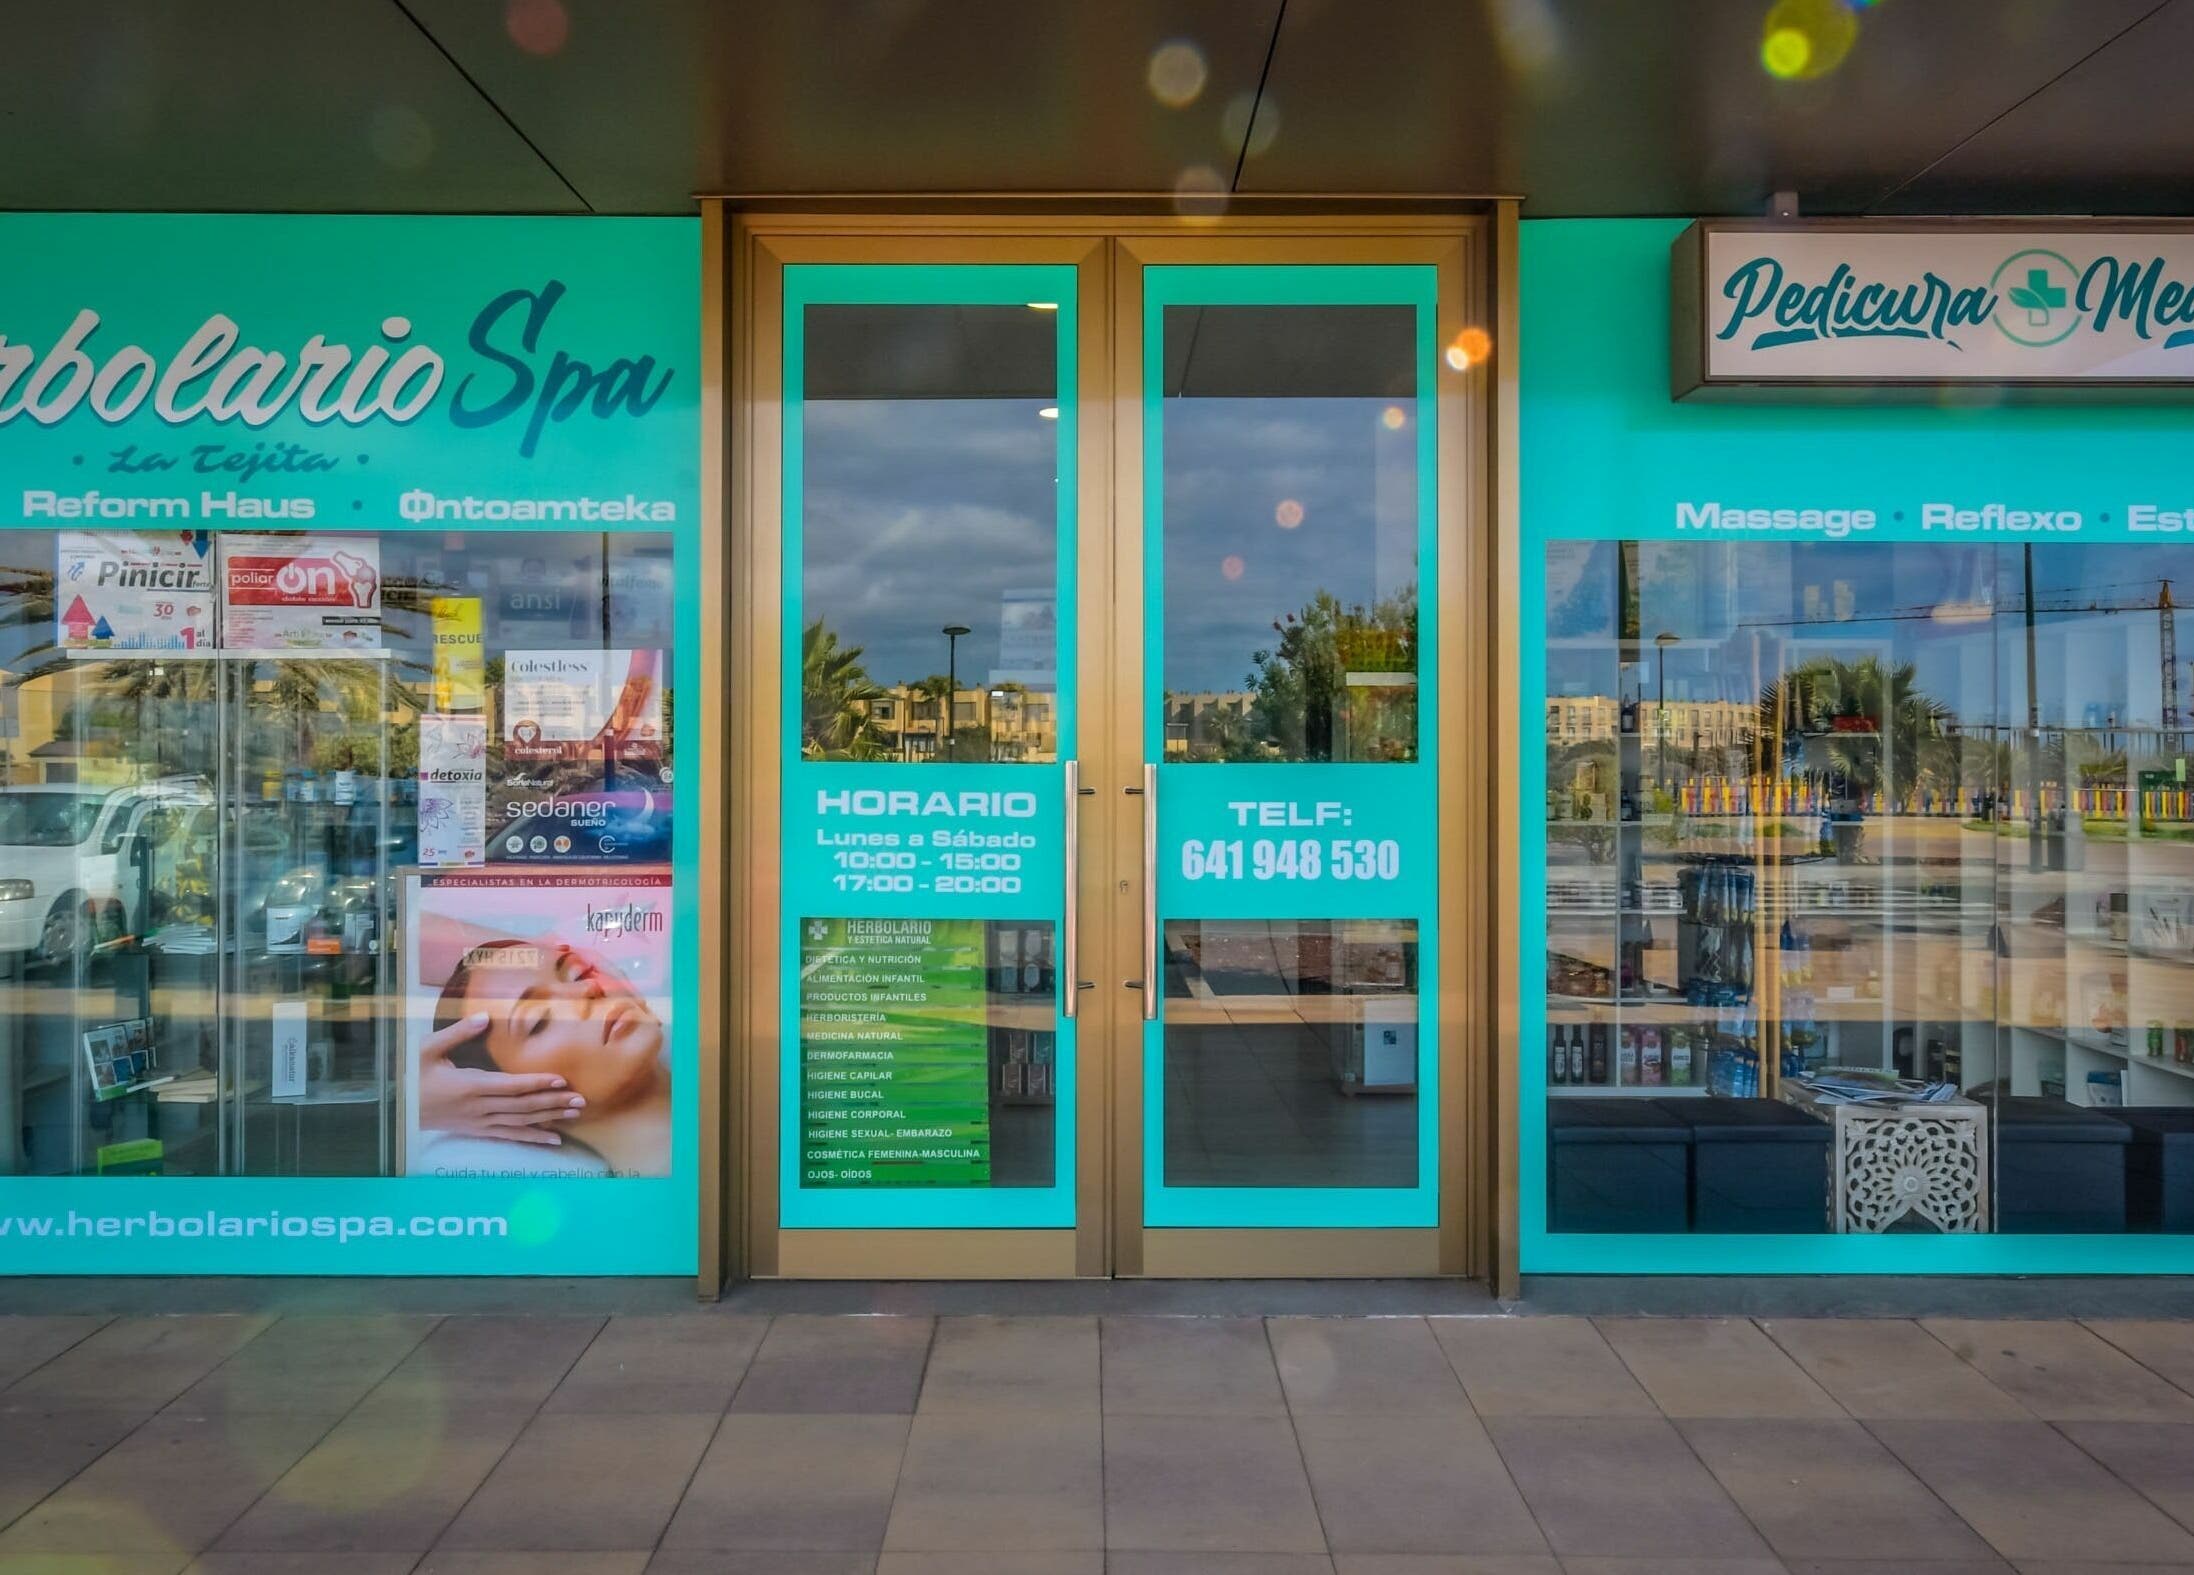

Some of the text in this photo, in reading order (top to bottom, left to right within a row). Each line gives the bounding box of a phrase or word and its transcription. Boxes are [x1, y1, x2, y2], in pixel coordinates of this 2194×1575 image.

[1715, 256, 1998, 341] Pedicura
[448, 279, 675, 459] Spa
[107, 441, 341, 484] La Tejita
[23, 490, 316, 520] Reform Haus
[1675, 502, 1877, 537] Massage
[1921, 503, 2083, 532] Reflexo
[97, 560, 200, 588] Pinicir
[231, 572, 274, 587] poliar
[153, 603, 174, 617] 30
[180, 627, 195, 650] 1
[506, 795, 617, 818] sedaner
[816, 789, 1037, 818] HORARIO
[570, 818, 607, 827] SUEÑO
[1227, 801, 1353, 826] TELF:
[816, 829, 1037, 848] Lunes a Sábado
[833, 851, 917, 869] 10:00
[939, 852, 1022, 871] 15:00
[1181, 839, 1400, 880] 641 948 530
[432, 878, 515, 887] ESPECIALISTAS
[519, 878, 534, 887] EN
[538, 878, 551, 887] LA
[832, 874, 914, 892] 17:00
[935, 875, 1022, 894] 20:00
[847, 920, 932, 935] HERBOLARIO
[895, 935, 931, 945] NATURAL
[859, 956, 865, 964] Y
[882, 974, 925, 983] INFANTIL
[806, 993, 927, 1002] PRODUCTOS INFANTILES
[806, 1032, 904, 1041] MEDICINA NATURAL
[807, 1071, 893, 1081] HIGIENE CAPILAR
[807, 1090, 884, 1100] HIGIENE BUCAL
[808, 1110, 907, 1119] HIGIENE CORPORAL
[808, 1130, 848, 1139] HIGIENE
[896, 1128, 953, 1138] EMBARAZO
